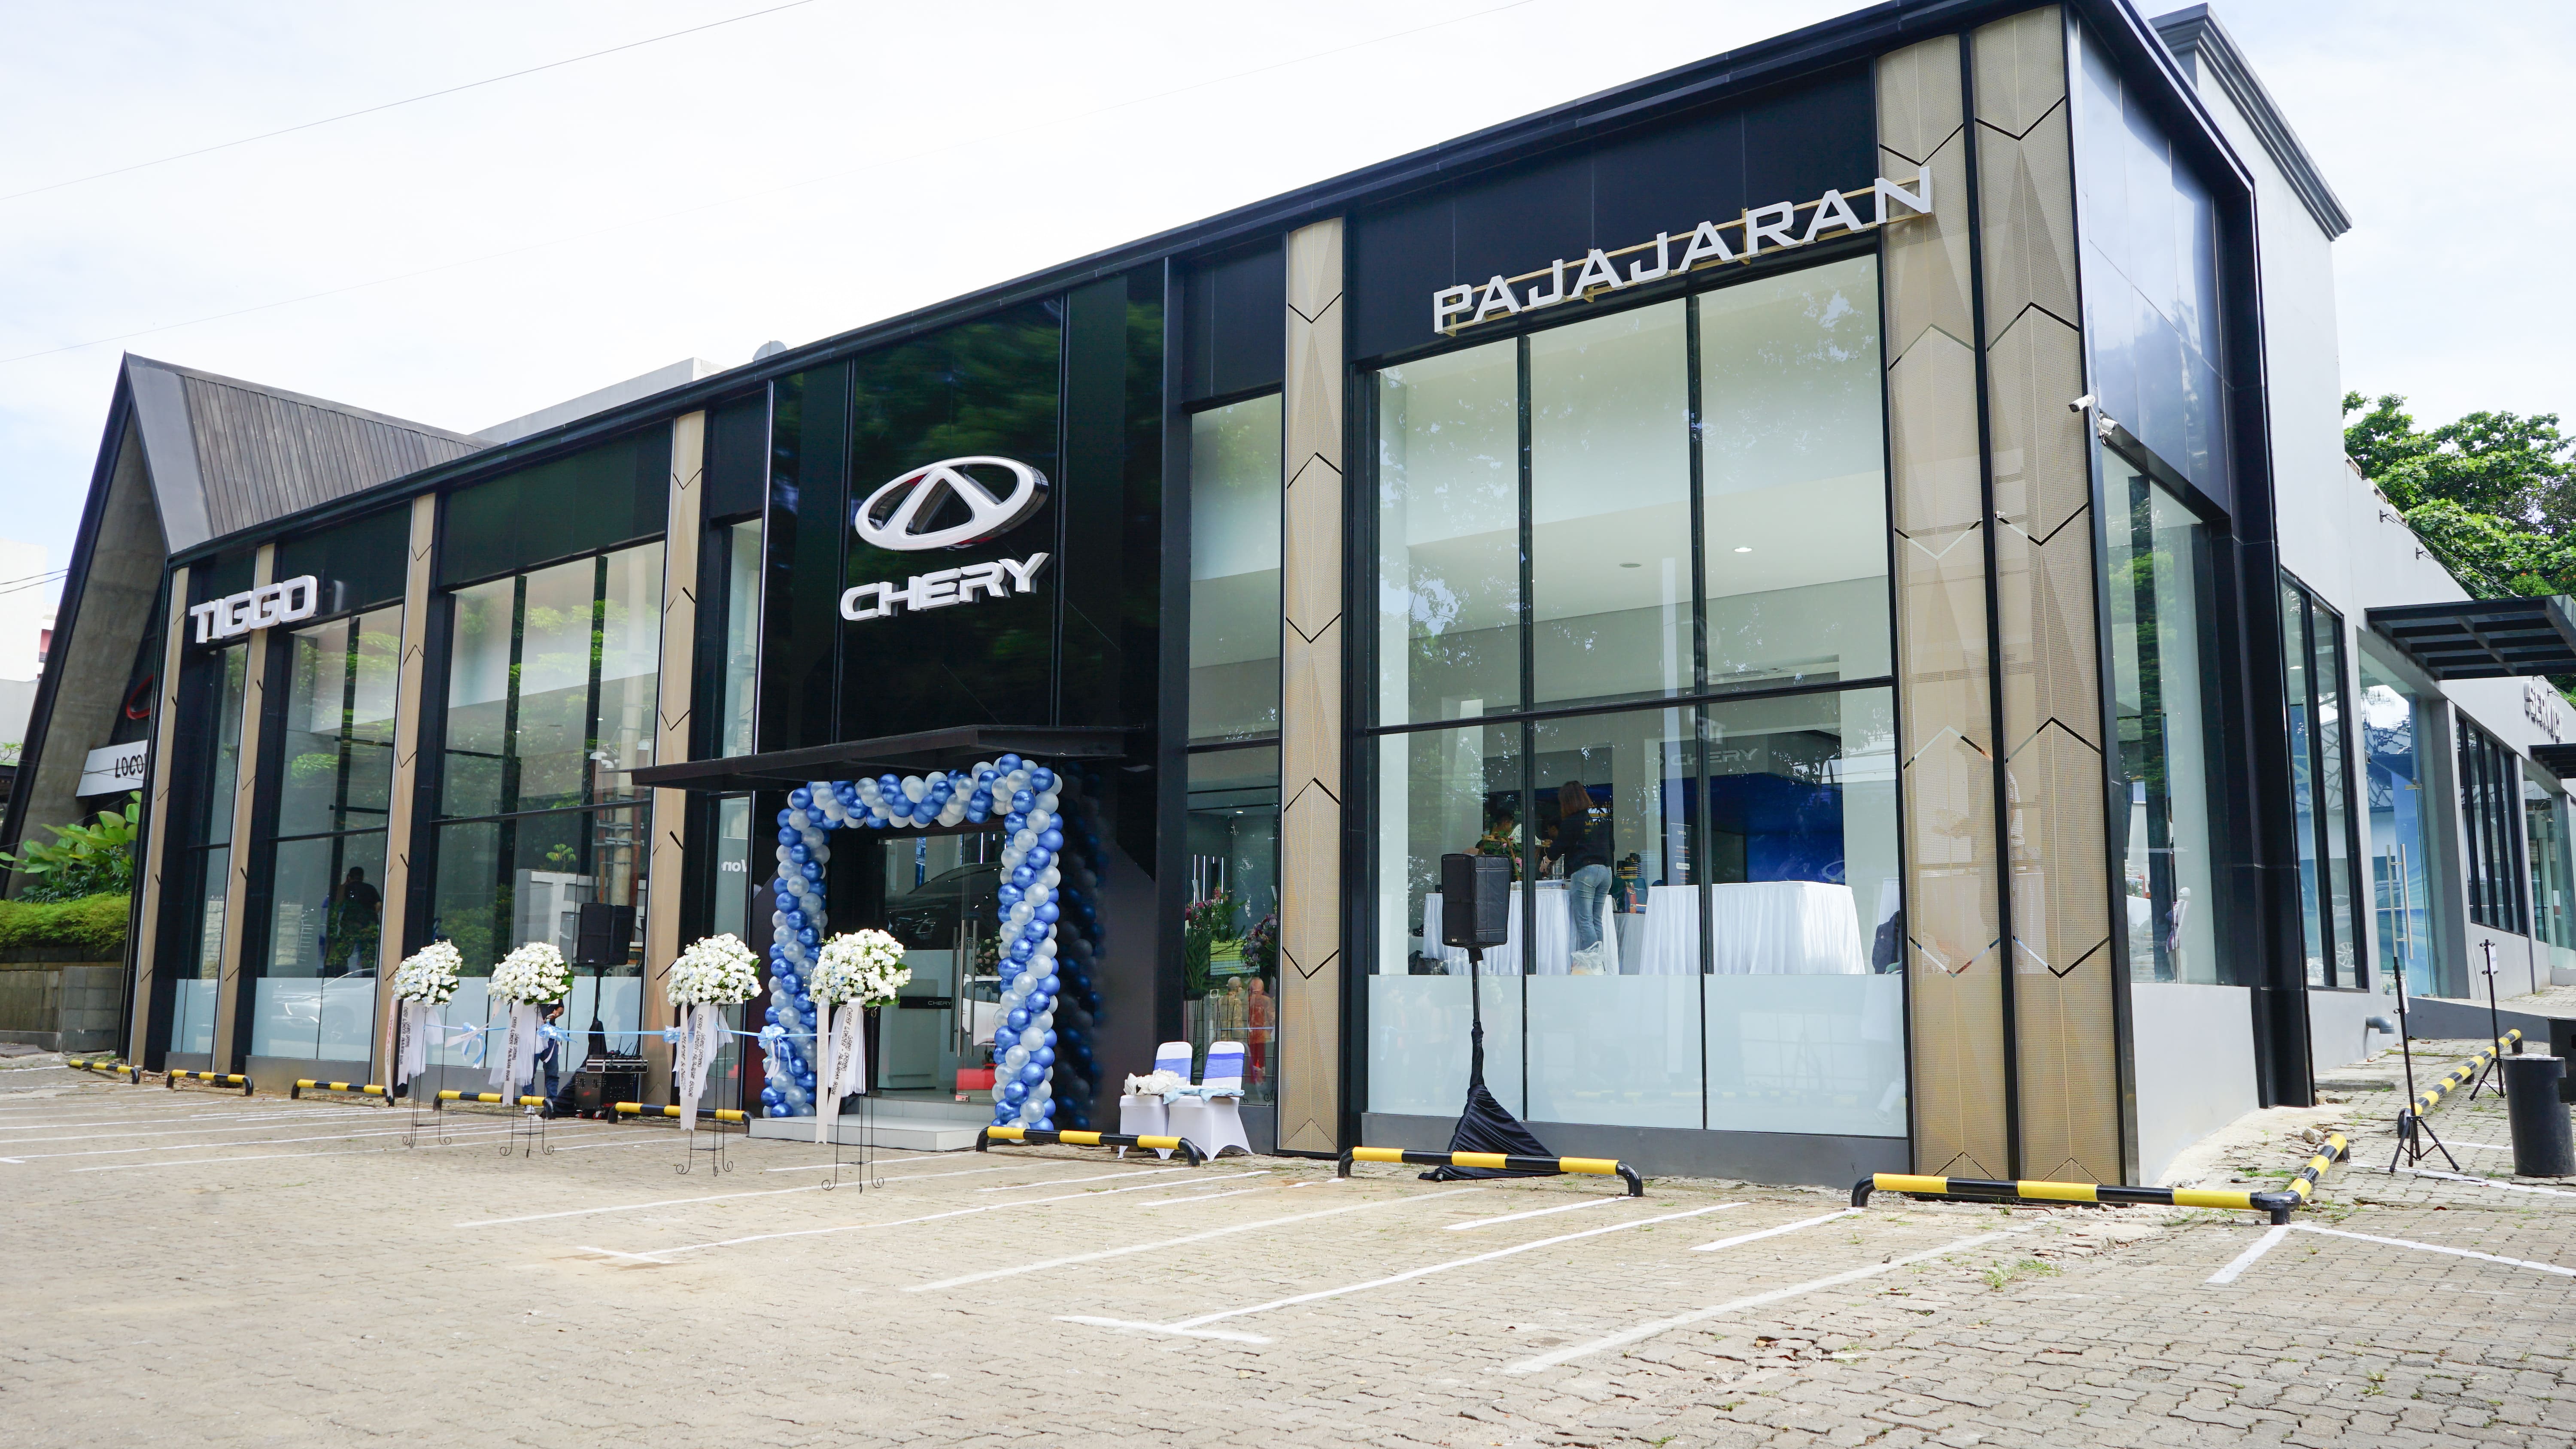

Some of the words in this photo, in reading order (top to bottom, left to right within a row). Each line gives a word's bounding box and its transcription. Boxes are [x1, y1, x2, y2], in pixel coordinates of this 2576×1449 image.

[1433, 166, 1934, 334] PAJAJARAN
[190, 575, 318, 643] TIGGO
[840, 552, 1049, 621] CHERY
[115, 753, 147, 778] LOCO
